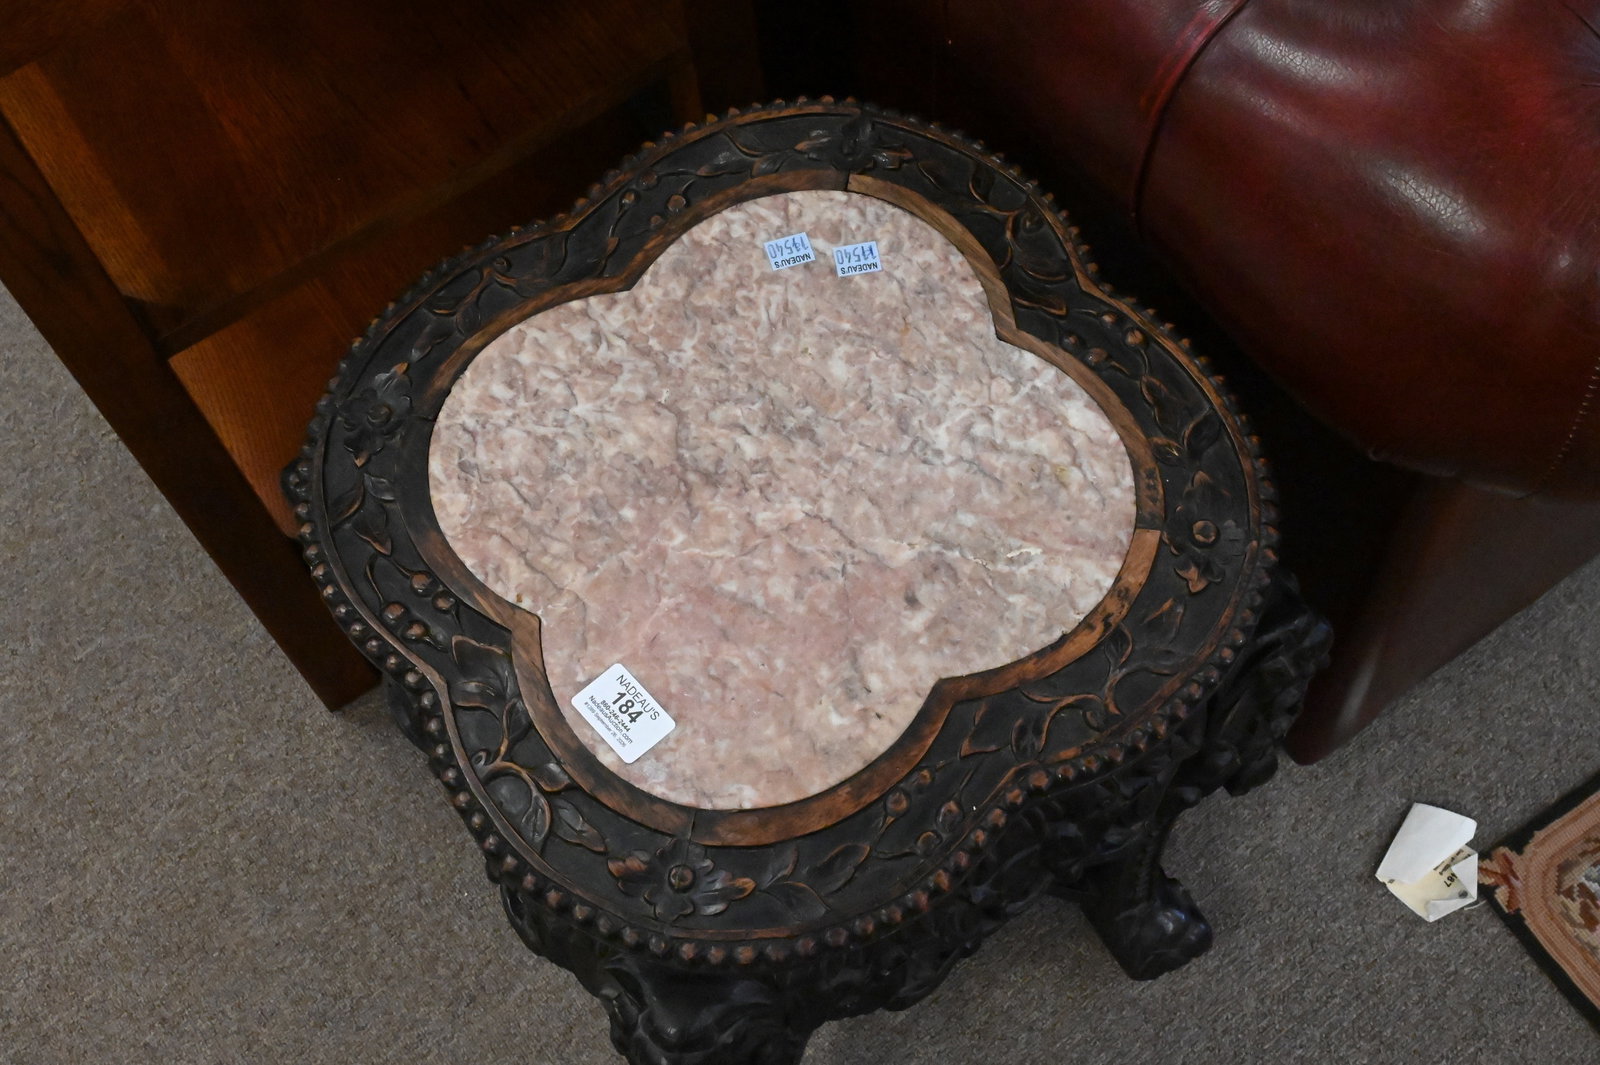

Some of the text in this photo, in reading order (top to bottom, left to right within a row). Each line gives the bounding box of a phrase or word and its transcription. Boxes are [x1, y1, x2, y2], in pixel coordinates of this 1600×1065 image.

[774, 253, 812, 268] NADEAU'S
[840, 262, 878, 274] NADEAU'S
[612, 692, 644, 724] 184
[616, 674, 660, 721] NADEAU'S
[588, 695, 634, 744] NadeausAuction.com
